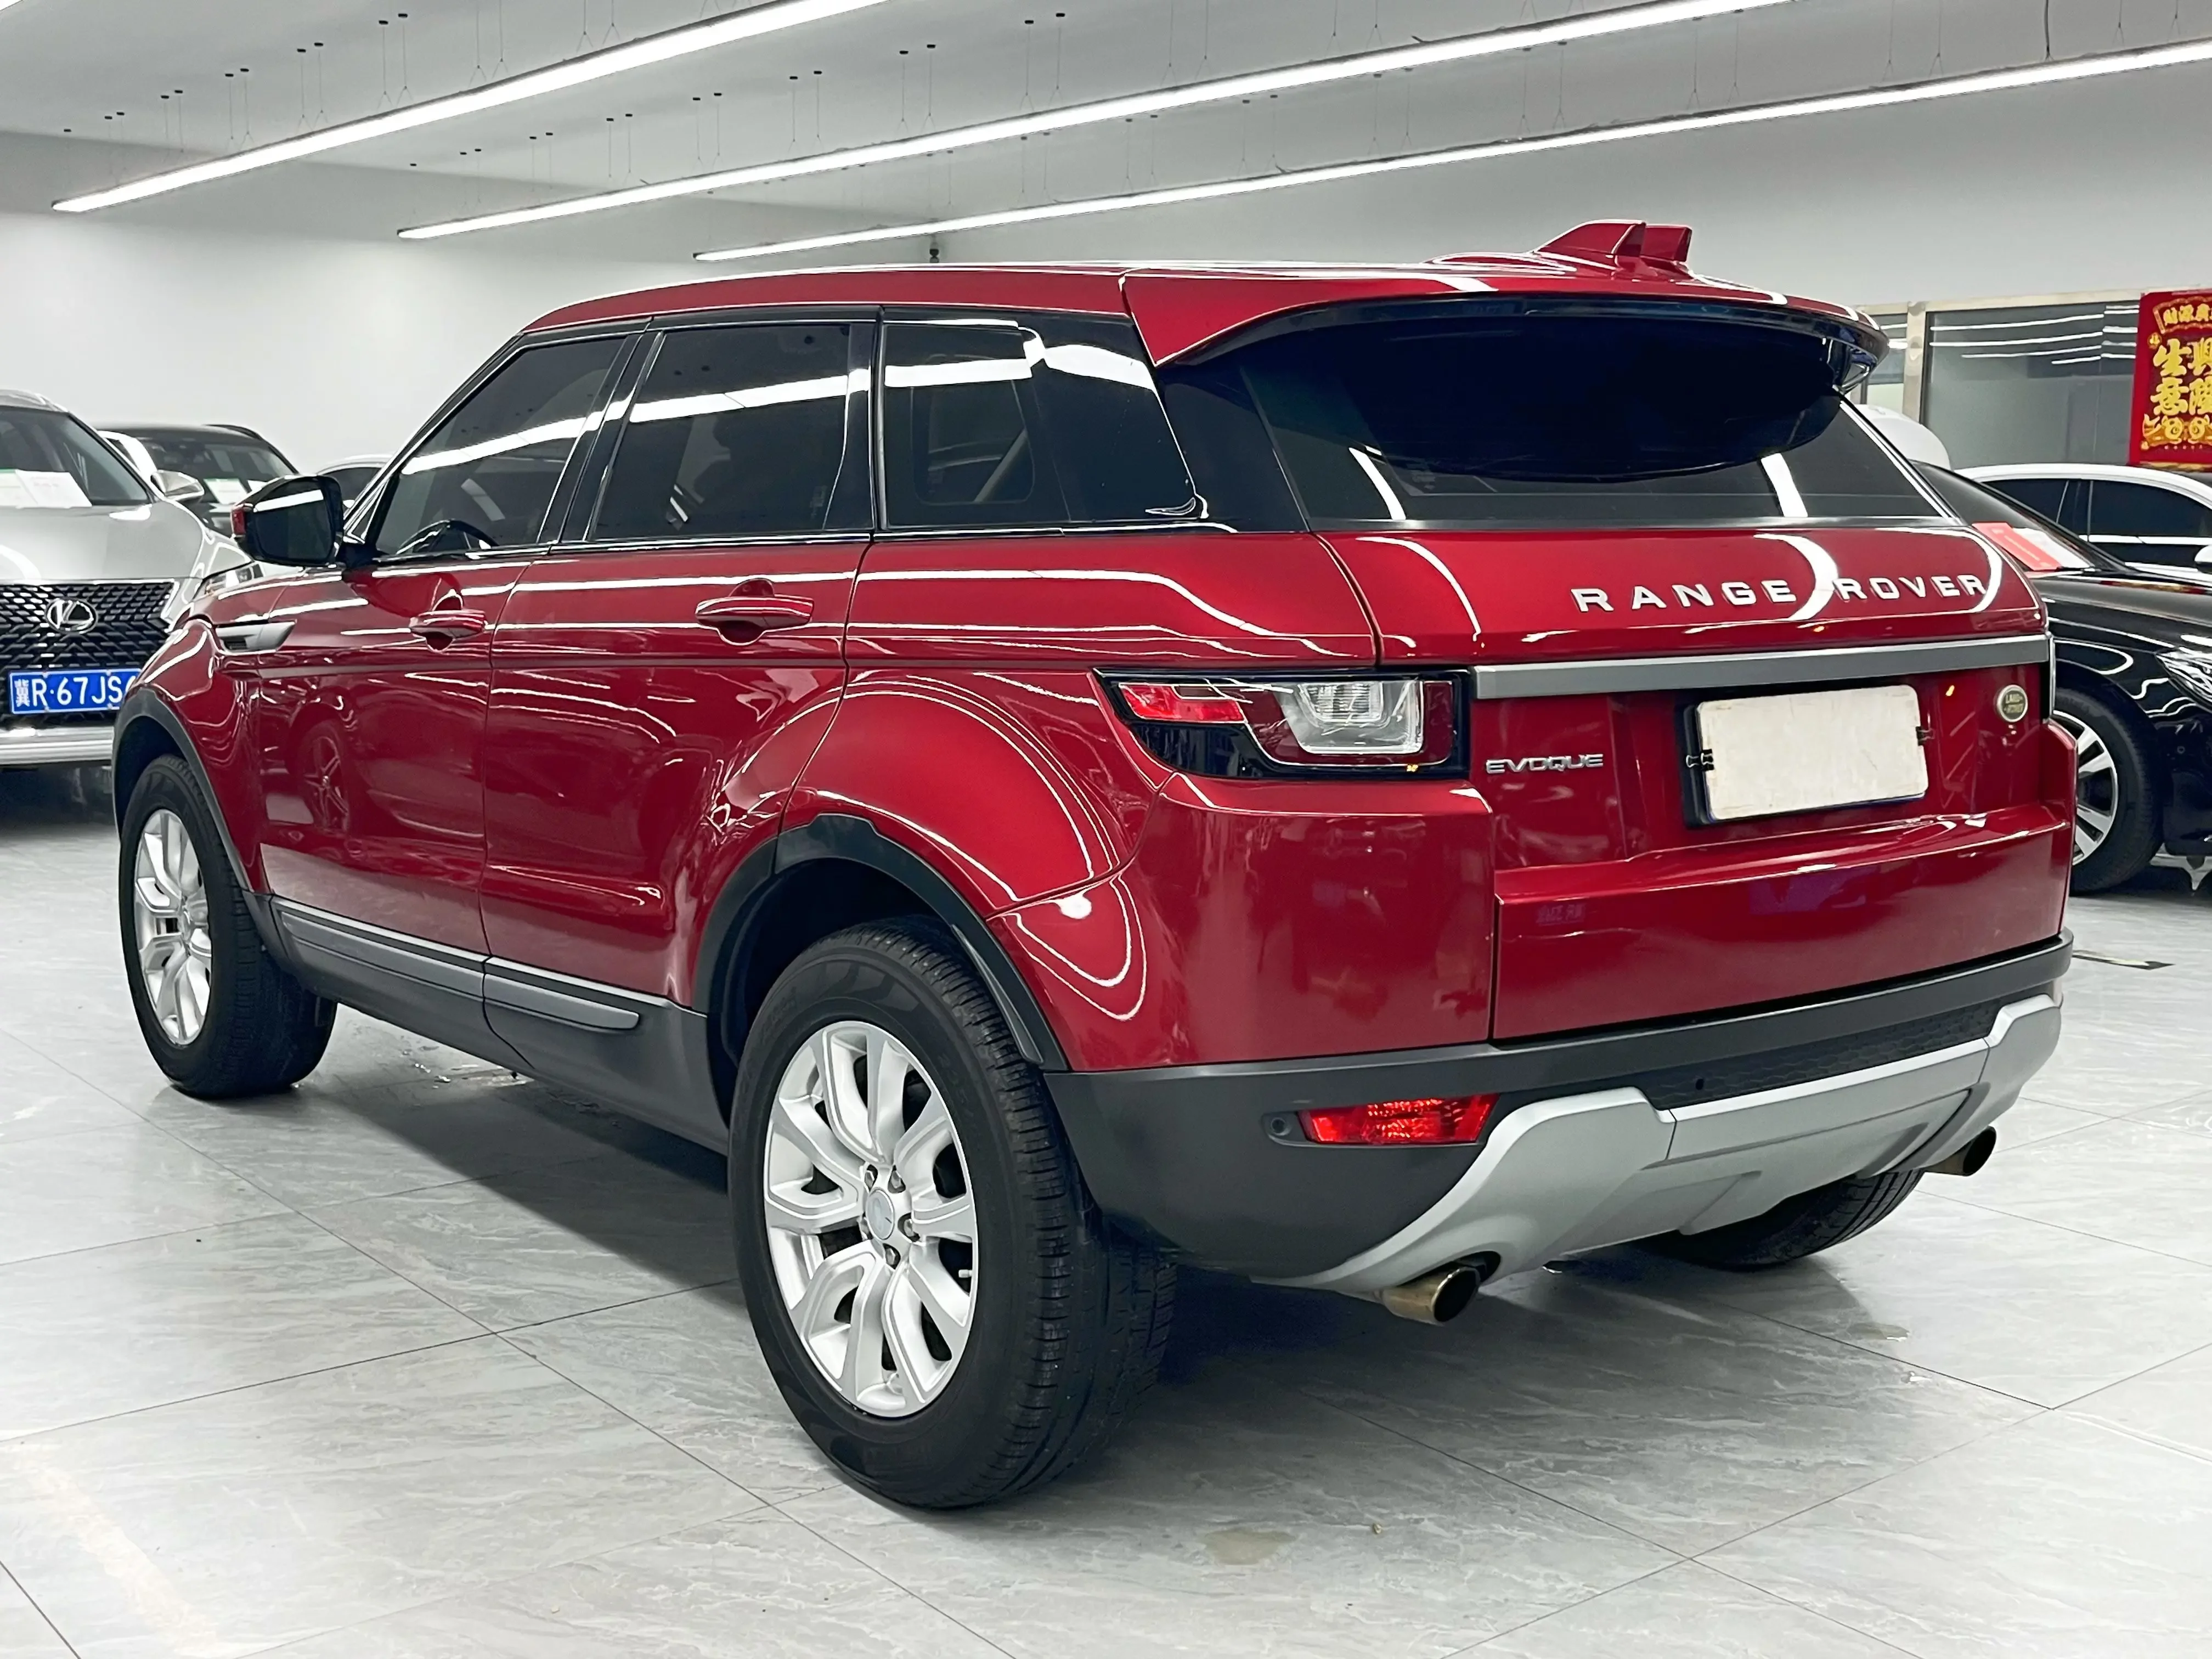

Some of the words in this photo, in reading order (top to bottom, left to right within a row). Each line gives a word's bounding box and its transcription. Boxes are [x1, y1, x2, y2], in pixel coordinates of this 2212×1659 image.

[1570, 579, 1797, 612] RANGE
[1832, 574, 1987, 601] ROVER
[1486, 753, 1604, 774] EVOQUE
